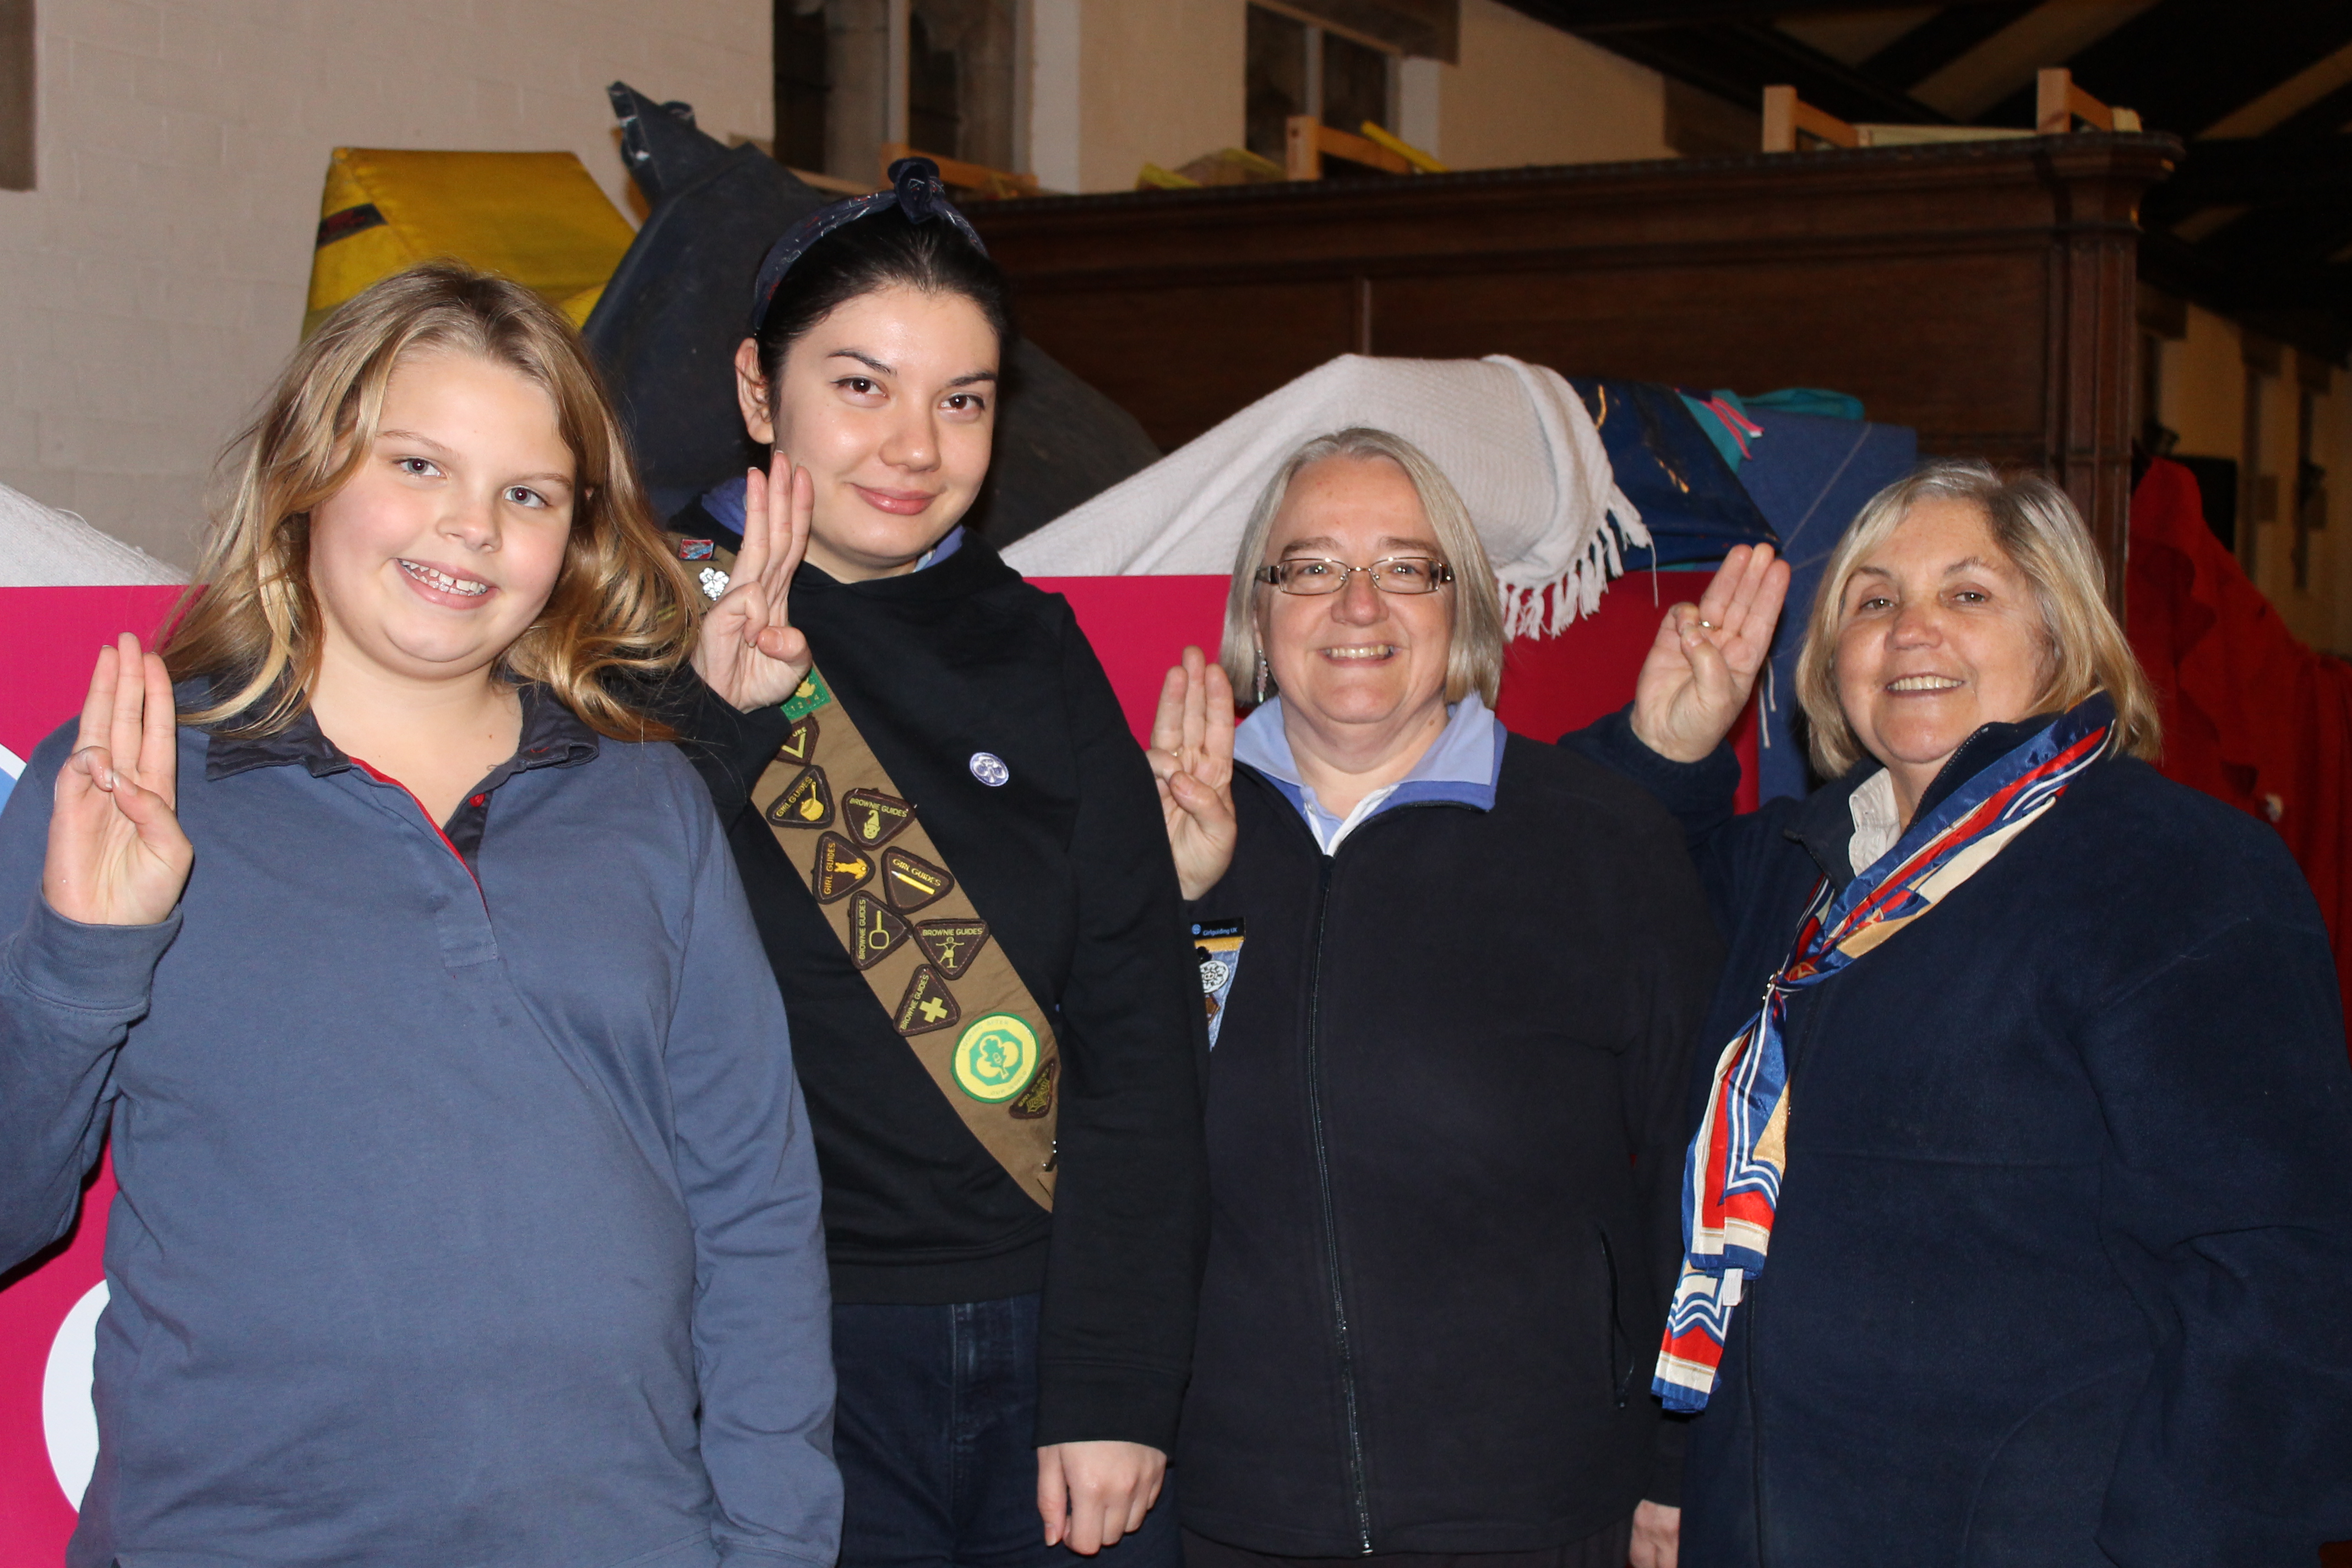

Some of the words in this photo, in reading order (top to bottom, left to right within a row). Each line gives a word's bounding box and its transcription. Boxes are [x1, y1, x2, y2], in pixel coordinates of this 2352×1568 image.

[792, 727, 807, 737] URE
[776, 802, 792, 817] GIRL
[788, 776, 813, 803] GUIDES
[850, 798, 881, 810] BROWNIE
[881, 805, 908, 818] GUIDES
[826, 843, 836, 872] GUIDES
[824, 875, 833, 895] GIRL
[892, 859, 910, 872] GIRL
[911, 868, 941, 886] GUIDES
[900, 999, 918, 1030] BROWNIE
[914, 974, 929, 1000] GUIDES
